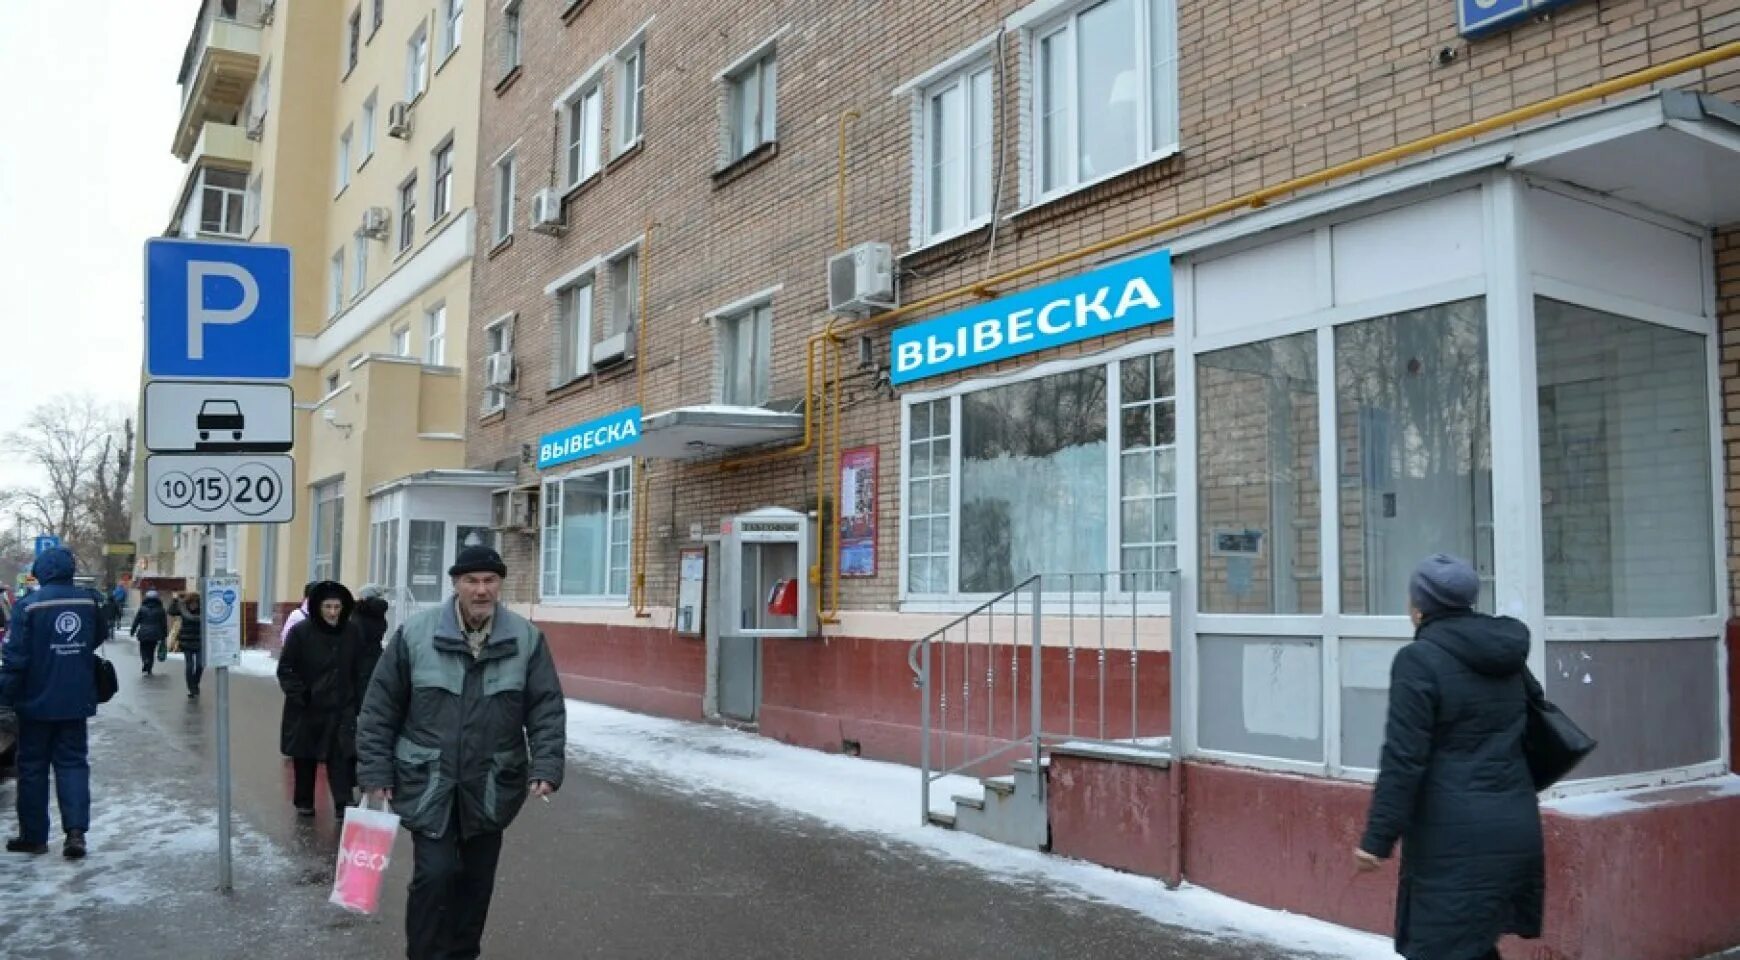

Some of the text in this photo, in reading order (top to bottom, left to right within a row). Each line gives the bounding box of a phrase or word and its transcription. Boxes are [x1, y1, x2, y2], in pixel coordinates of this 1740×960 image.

[187, 260, 259, 359] P
[897, 276, 1161, 372] ВЫВЕСКА
[540, 418, 637, 462] ВЫВЕСКА
[163, 476, 275, 503] 10 15 20
